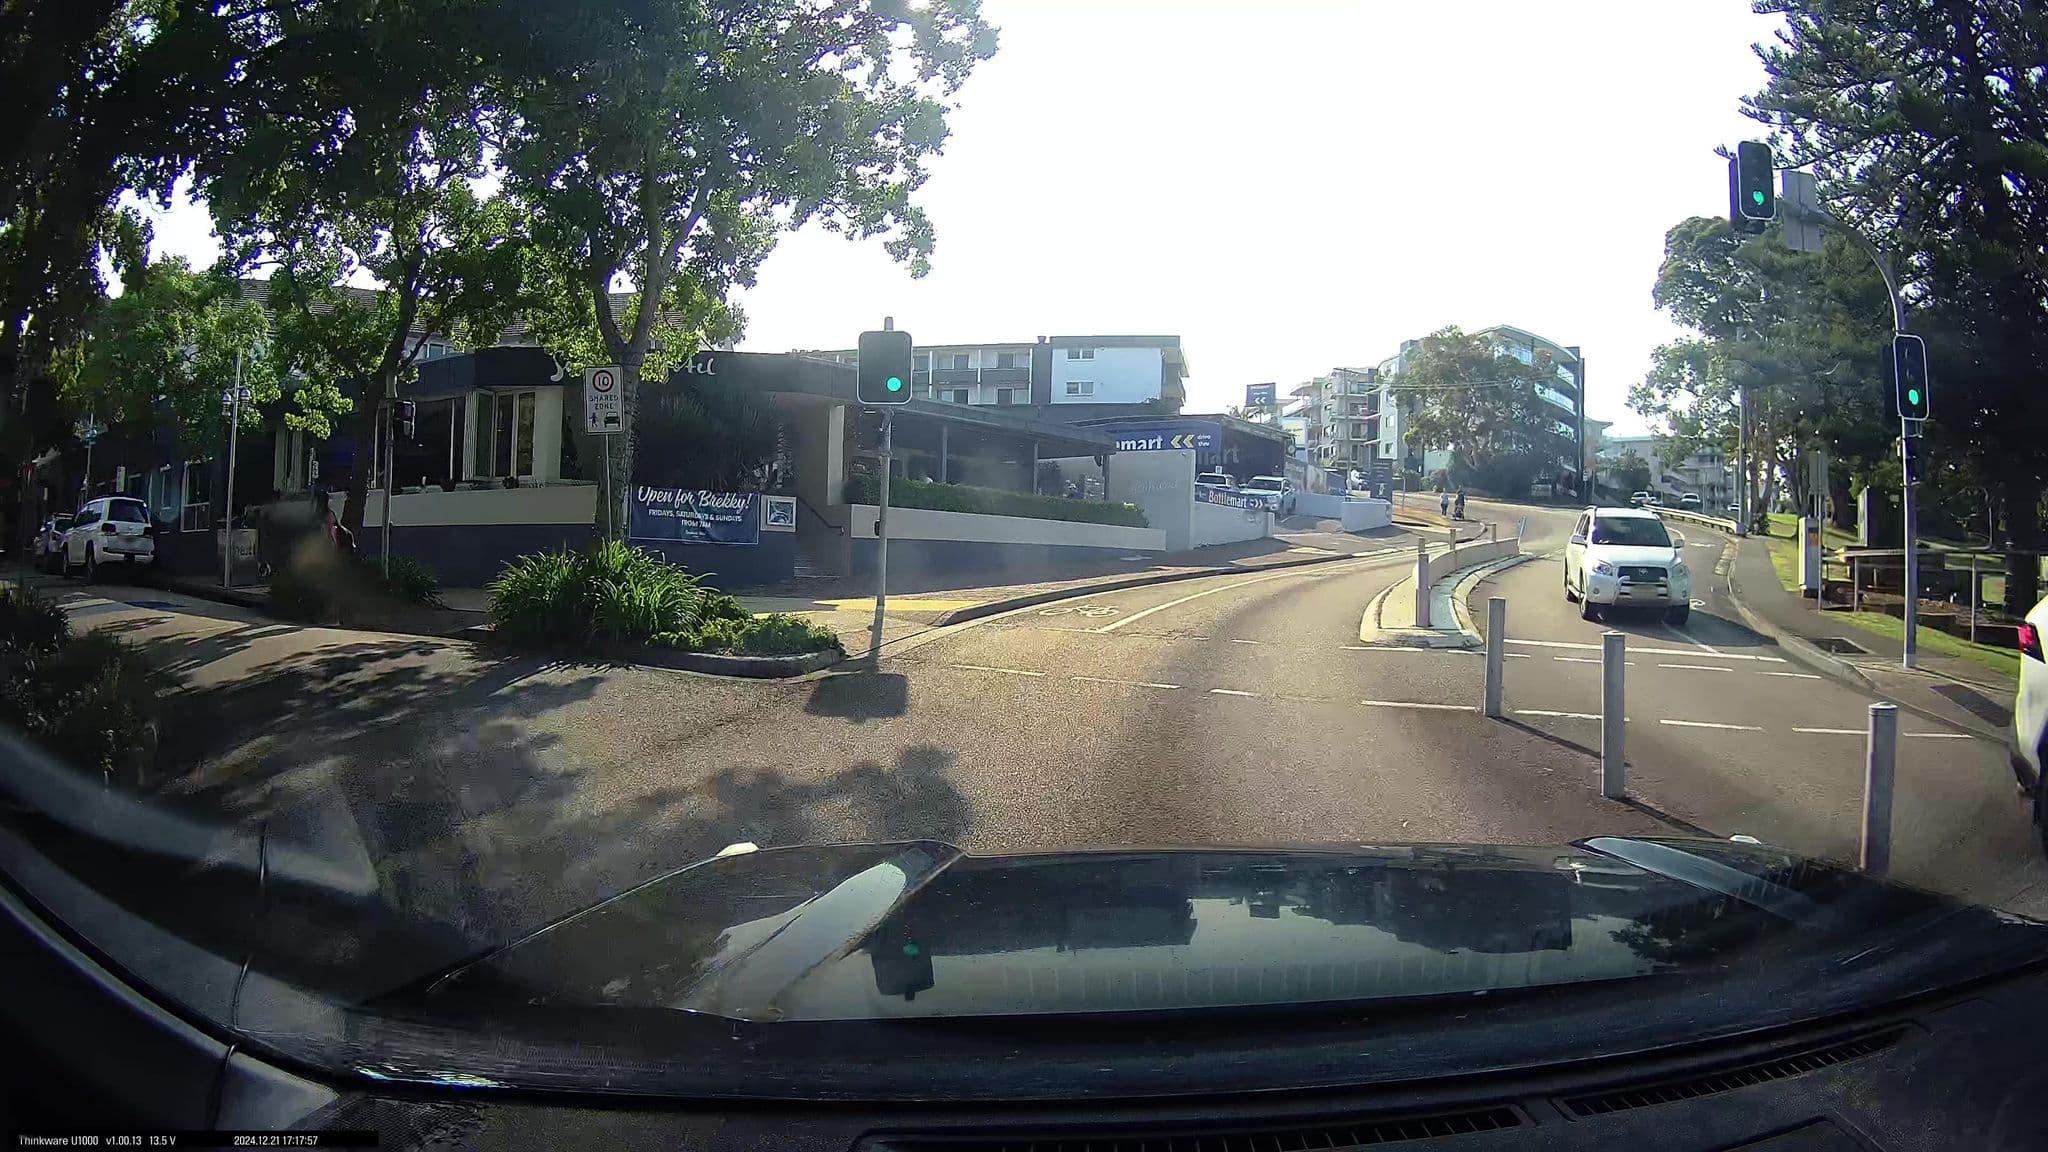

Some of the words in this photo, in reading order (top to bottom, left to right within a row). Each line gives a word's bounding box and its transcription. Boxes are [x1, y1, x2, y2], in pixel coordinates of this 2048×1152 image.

[598, 376, 610, 387] 10
[590, 394, 619, 402] SHARED
[594, 402, 615, 410] ZONE
[638, 486, 674, 506] Open
[674, 488, 695, 509] for
[698, 490, 752, 514] Brekky!
[1208, 490, 1247, 508] Bottlemart
[681, 519, 698, 527] FROM
[699, 520, 712, 528] 7AM
